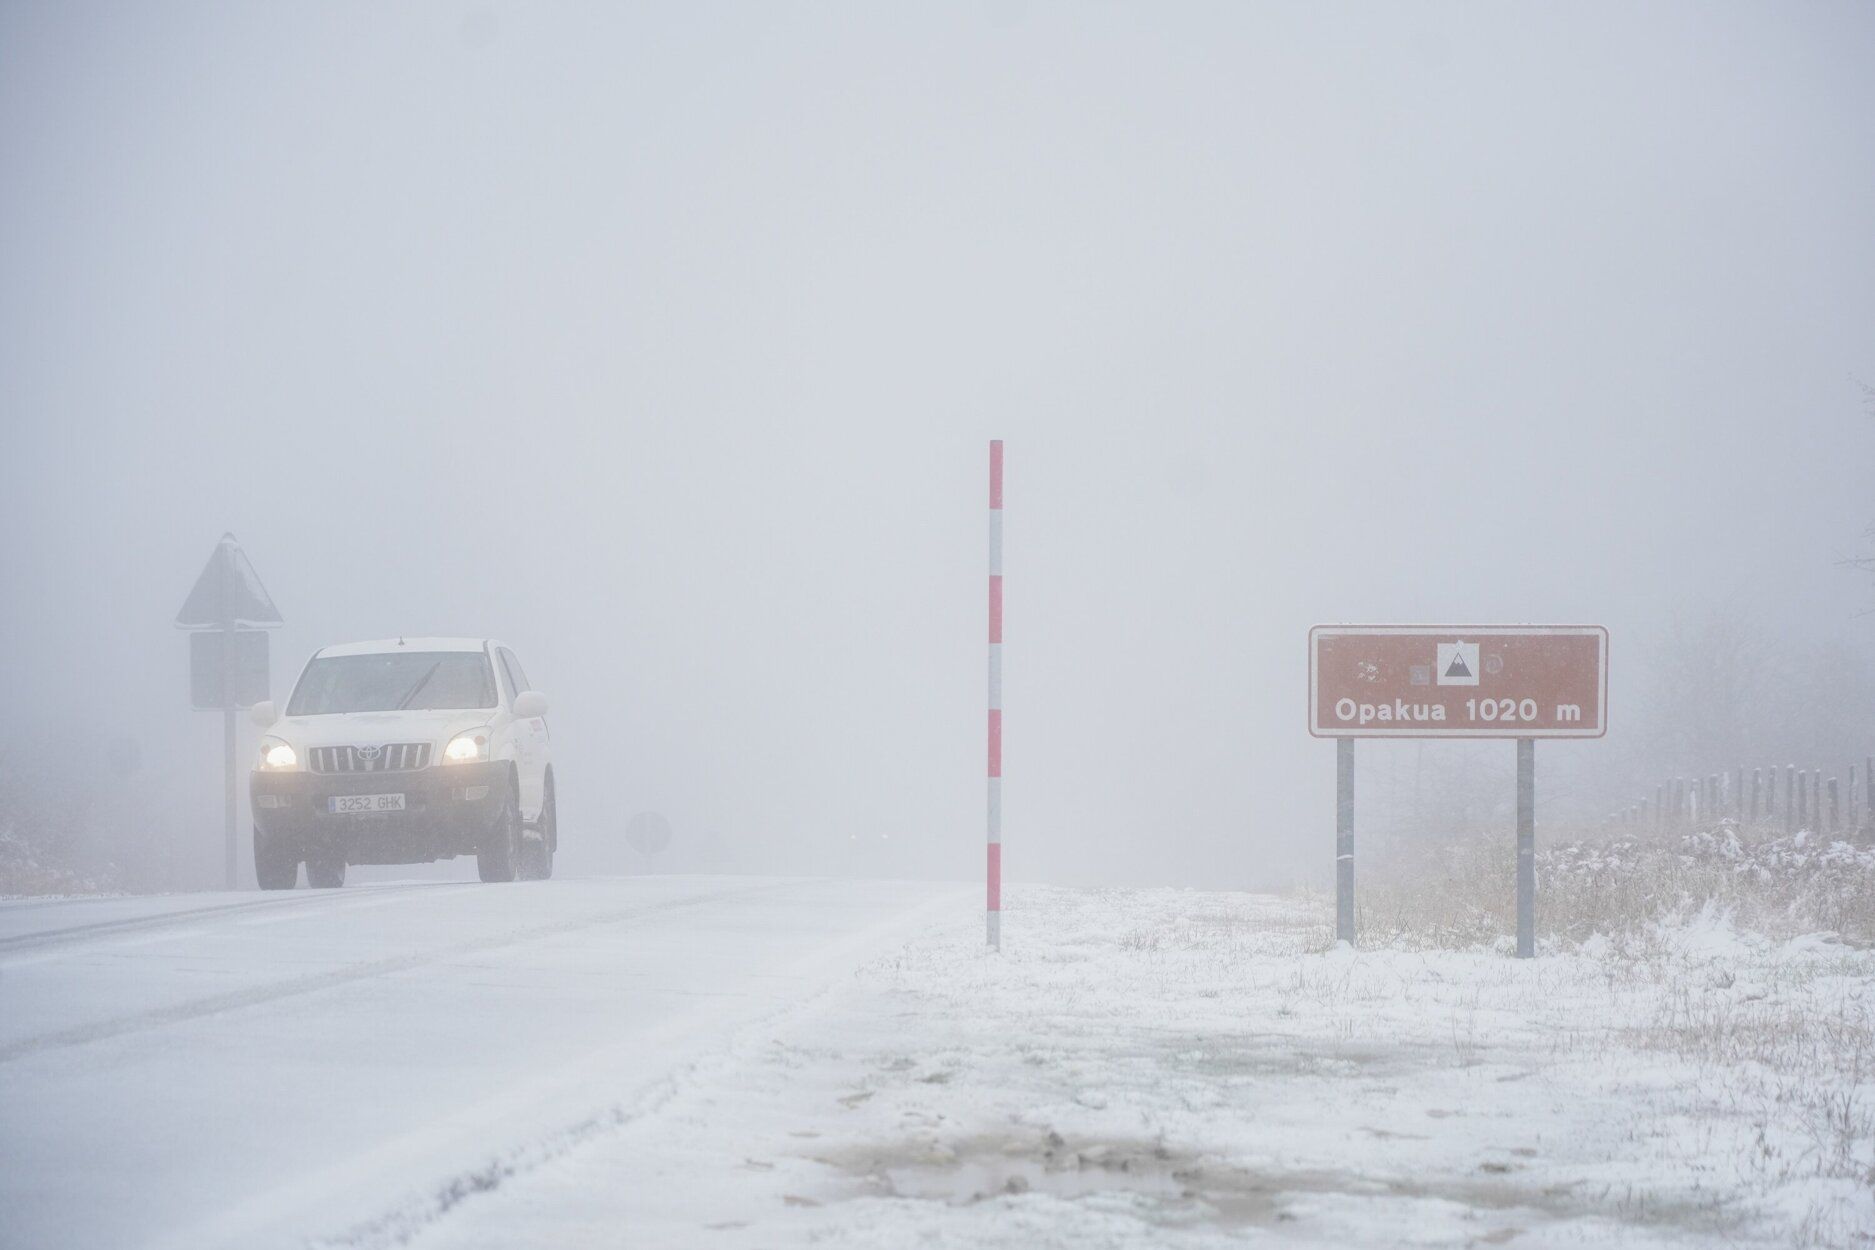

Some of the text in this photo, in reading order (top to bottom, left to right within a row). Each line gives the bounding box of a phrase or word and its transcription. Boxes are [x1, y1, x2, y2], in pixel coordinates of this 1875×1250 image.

[1335, 697, 1581, 724] Opakua 1020 m
[340, 795, 402, 811] 3252 GHK
